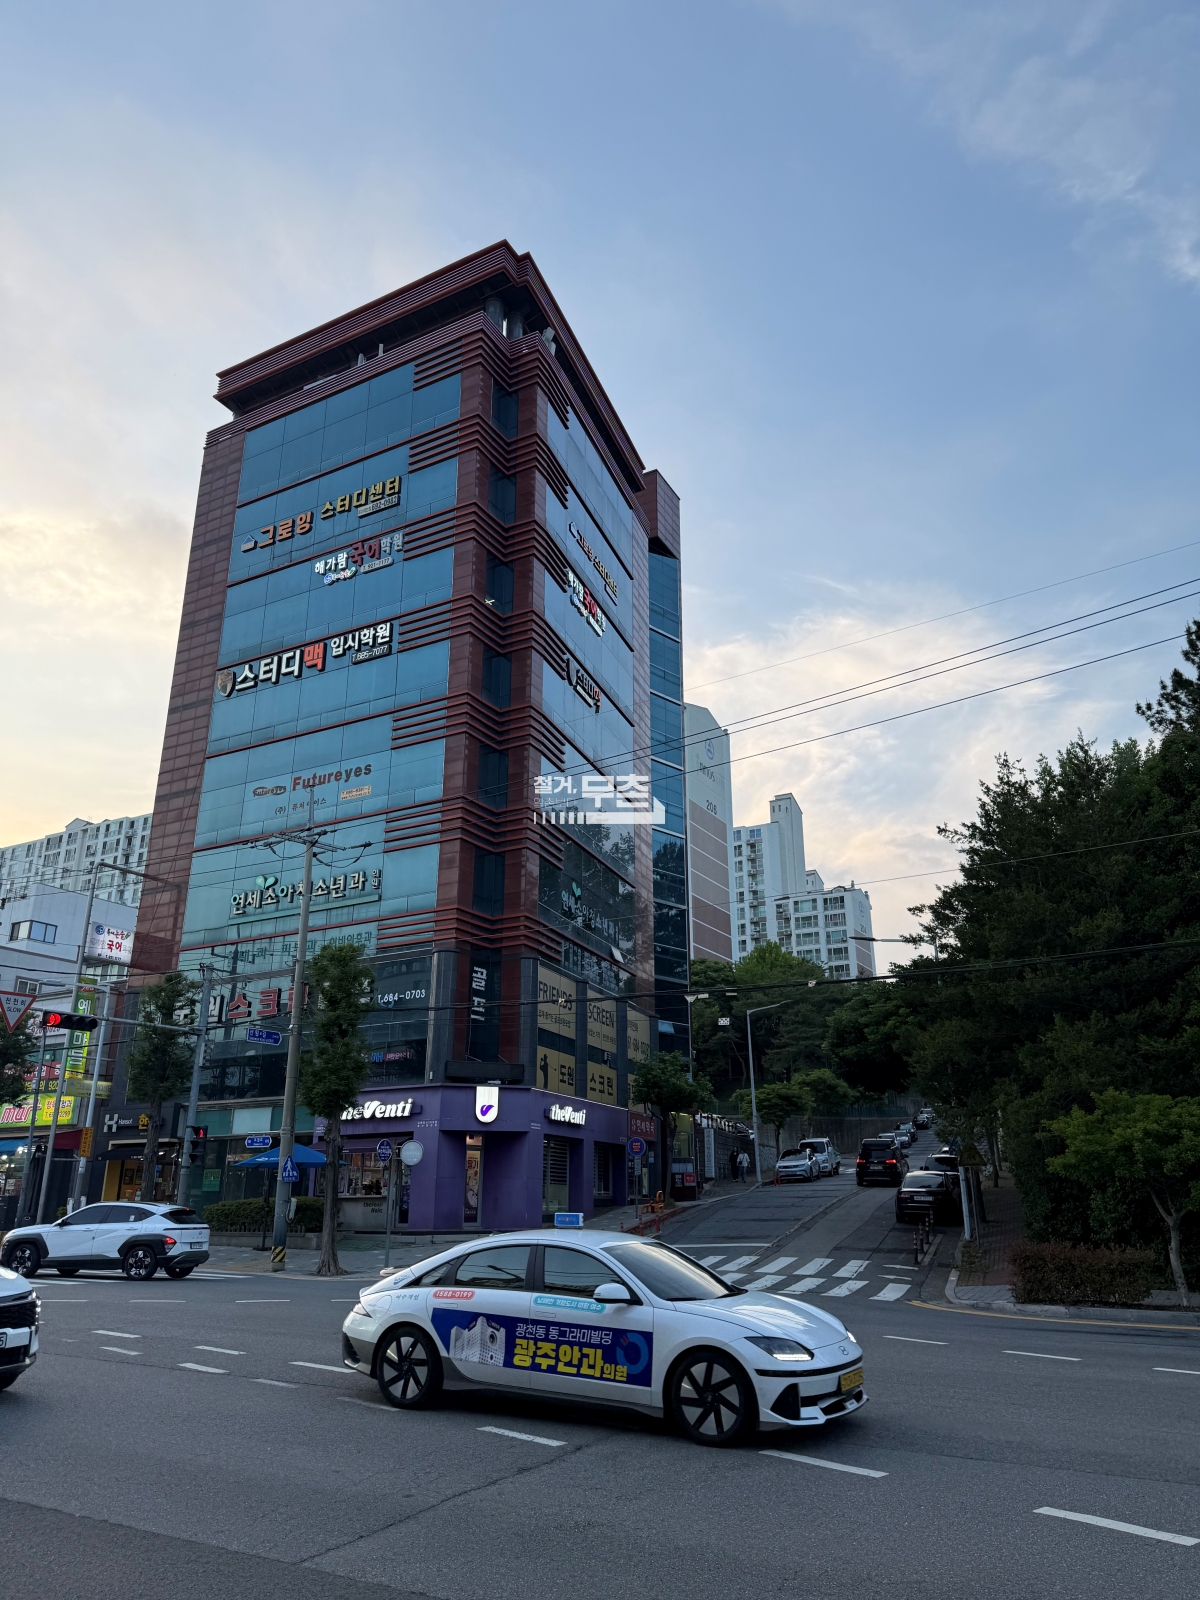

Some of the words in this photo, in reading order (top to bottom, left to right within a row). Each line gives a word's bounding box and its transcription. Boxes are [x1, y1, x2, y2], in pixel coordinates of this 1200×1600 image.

[258, 511, 313, 548] 그로잉
[320, 476, 400, 518] 스터디센터
[234, 642, 326, 691] 스터디맥
[331, 622, 391, 656] 입시학원
[292, 763, 373, 792] Futureyes
[706, 799, 718, 815] 206
[538, 980, 573, 1012] FRIENDS
[588, 1003, 615, 1029] SCREEN
[589, 1072, 615, 1097] 스크린
[550, 1104, 586, 1126] theVenti
[435, 1290, 473, 1299] 1588-0199
[515, 1323, 547, 1339] 광천동
[549, 1326, 613, 1345] 동그라미빌딩
